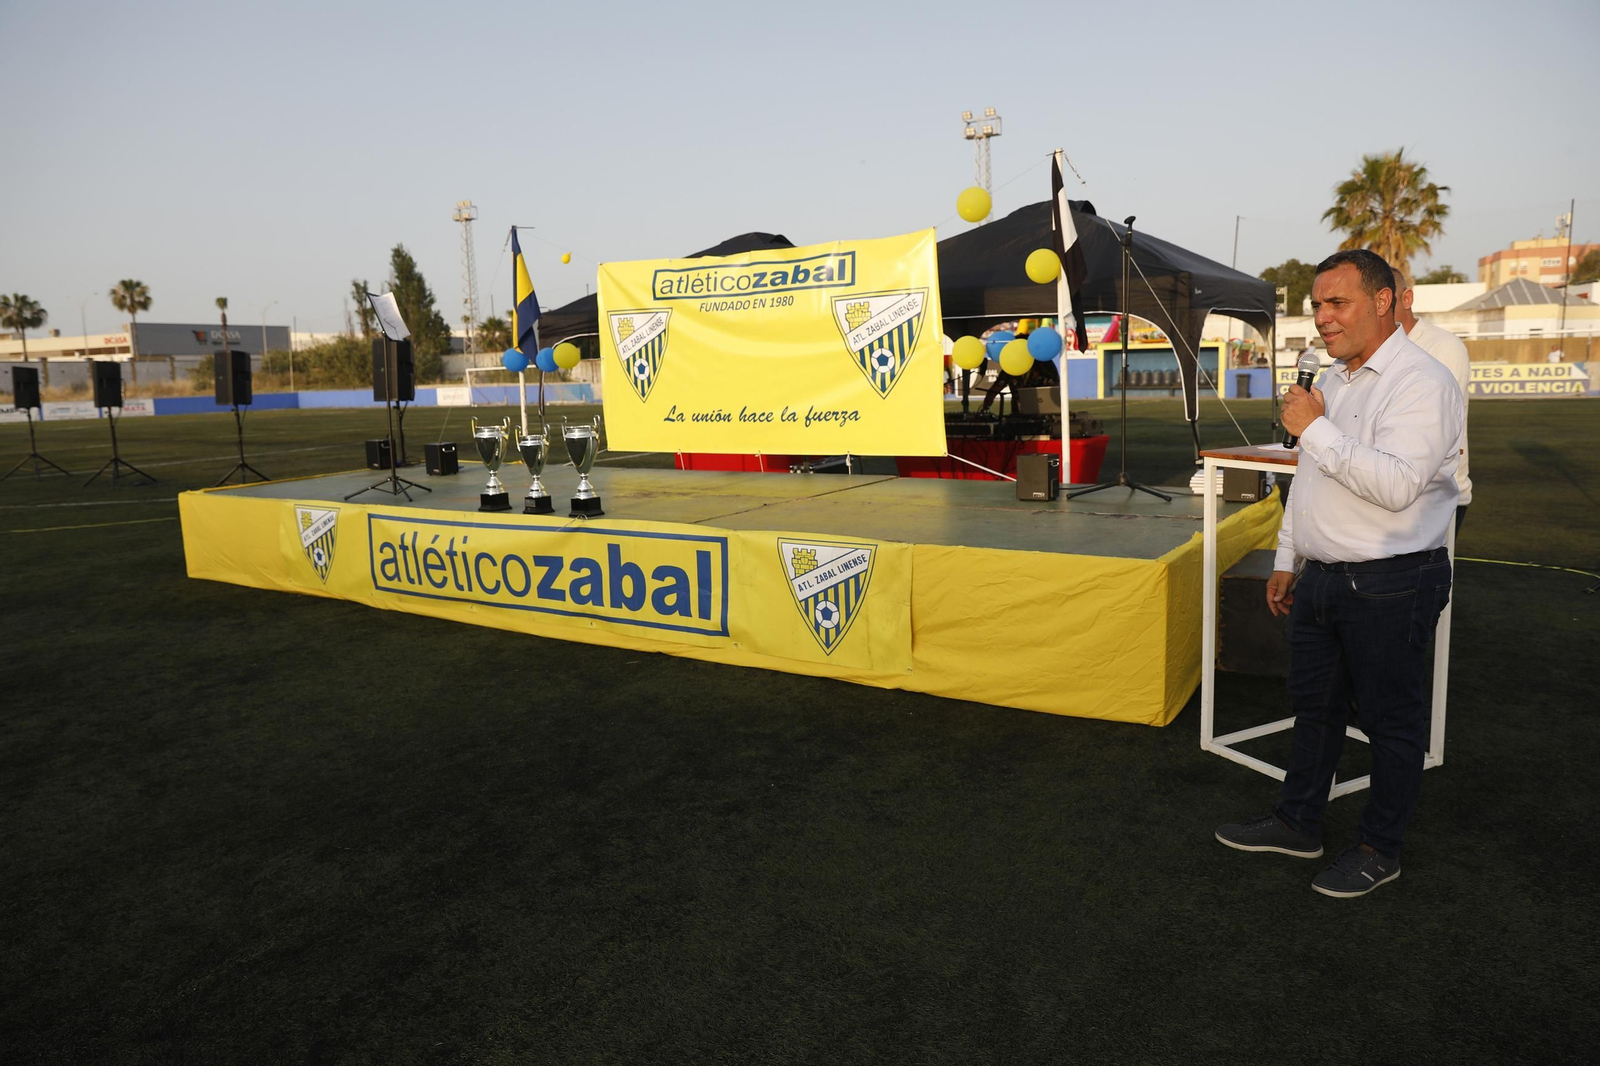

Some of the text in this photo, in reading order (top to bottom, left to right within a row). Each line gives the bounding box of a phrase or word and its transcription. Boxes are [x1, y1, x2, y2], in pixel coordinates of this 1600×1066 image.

[660, 258, 846, 295] atléticozabal
[699, 295, 795, 313] FUNDADO EN 1980
[631, 332, 647, 348] ZABAL
[645, 316, 664, 336] LINENSE
[852, 298, 919, 346] ATL. ZABAL LINENSE
[1281, 371, 1298, 381] RE
[1471, 367, 1503, 378] TES
[1509, 367, 1521, 378] A
[1480, 380, 1586, 394] VIOLENCIA
[663, 404, 861, 428] La unión hace la fuerza
[379, 531, 712, 621] atléticozabal
[797, 554, 867, 593] ATL. ZABAL LINENSE
